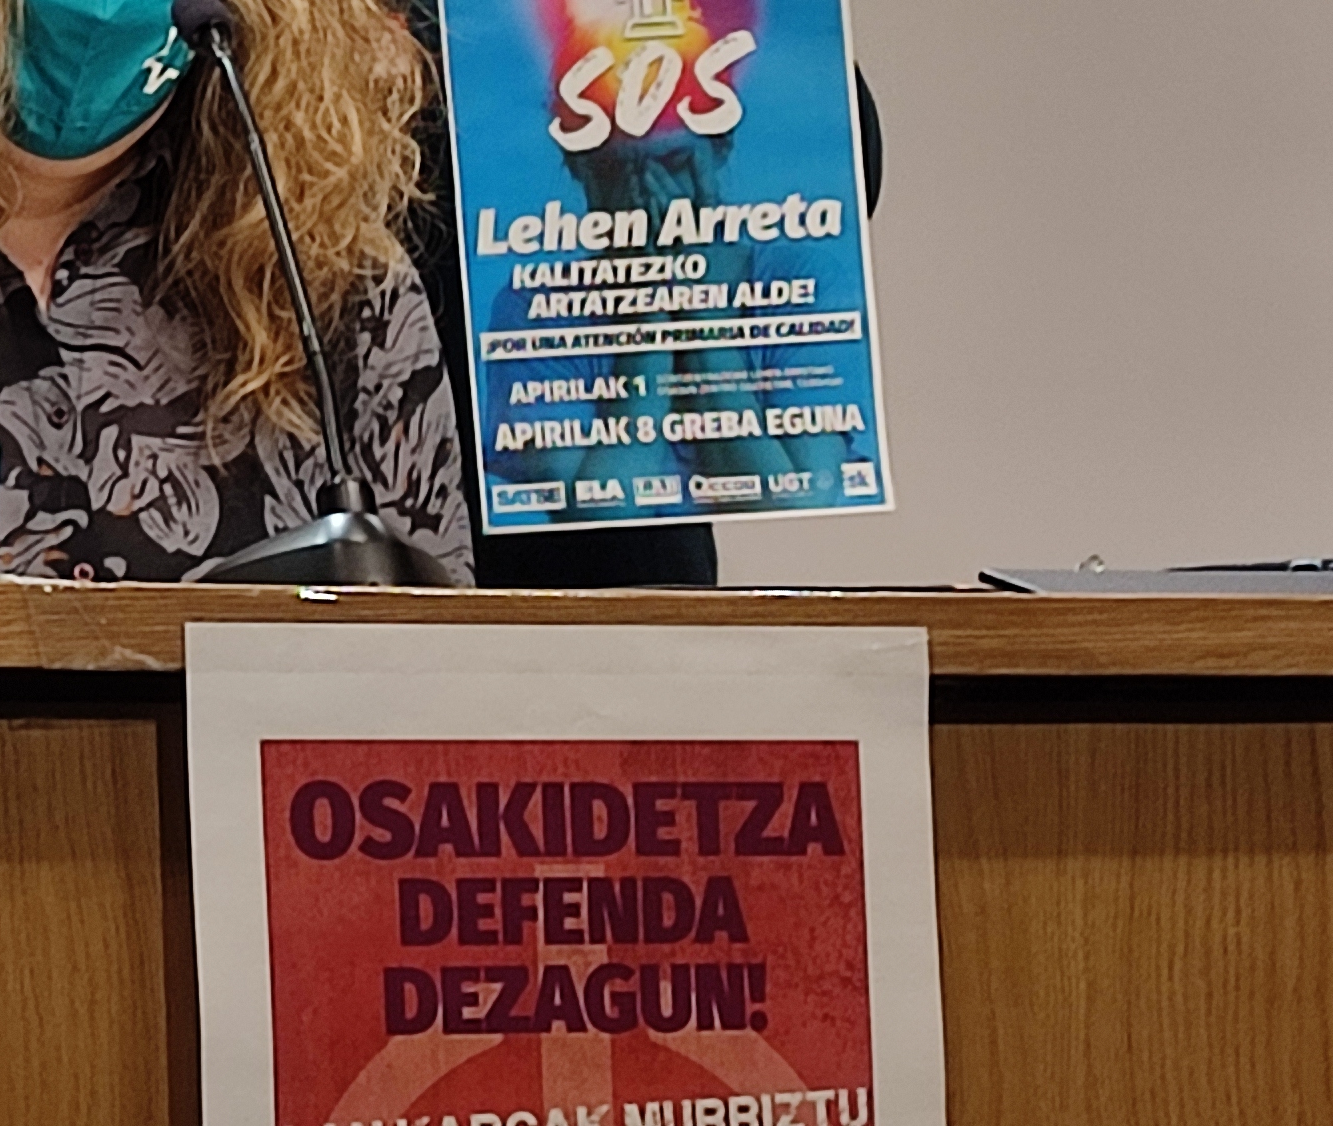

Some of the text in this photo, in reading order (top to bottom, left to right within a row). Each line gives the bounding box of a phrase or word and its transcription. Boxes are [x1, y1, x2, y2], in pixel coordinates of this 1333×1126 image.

[548, 29, 756, 152] SOS
[476, 192, 842, 256] Lehen Arreta
[512, 254, 707, 289] KALITATEZKO
[527, 278, 815, 320] ARTATZEAREN ALDE!
[531, 334, 568, 351] UNA
[571, 327, 657, 348] ATENCIÓN
[661, 324, 745, 343] PRIMARIA
[749, 323, 771, 338] DE
[776, 318, 855, 337] CALIDAD!
[510, 376, 629, 405] APIRILAK
[633, 375, 647, 396] 1
[495, 404, 865, 452] APIRILAK 8 GREBA EGUNA
[768, 472, 812, 492] UGT
[289, 778, 845, 861] OSAKIDETZA
[397, 876, 749, 947] DEFENDA
[383, 961, 769, 1035] DEZAGUN!
